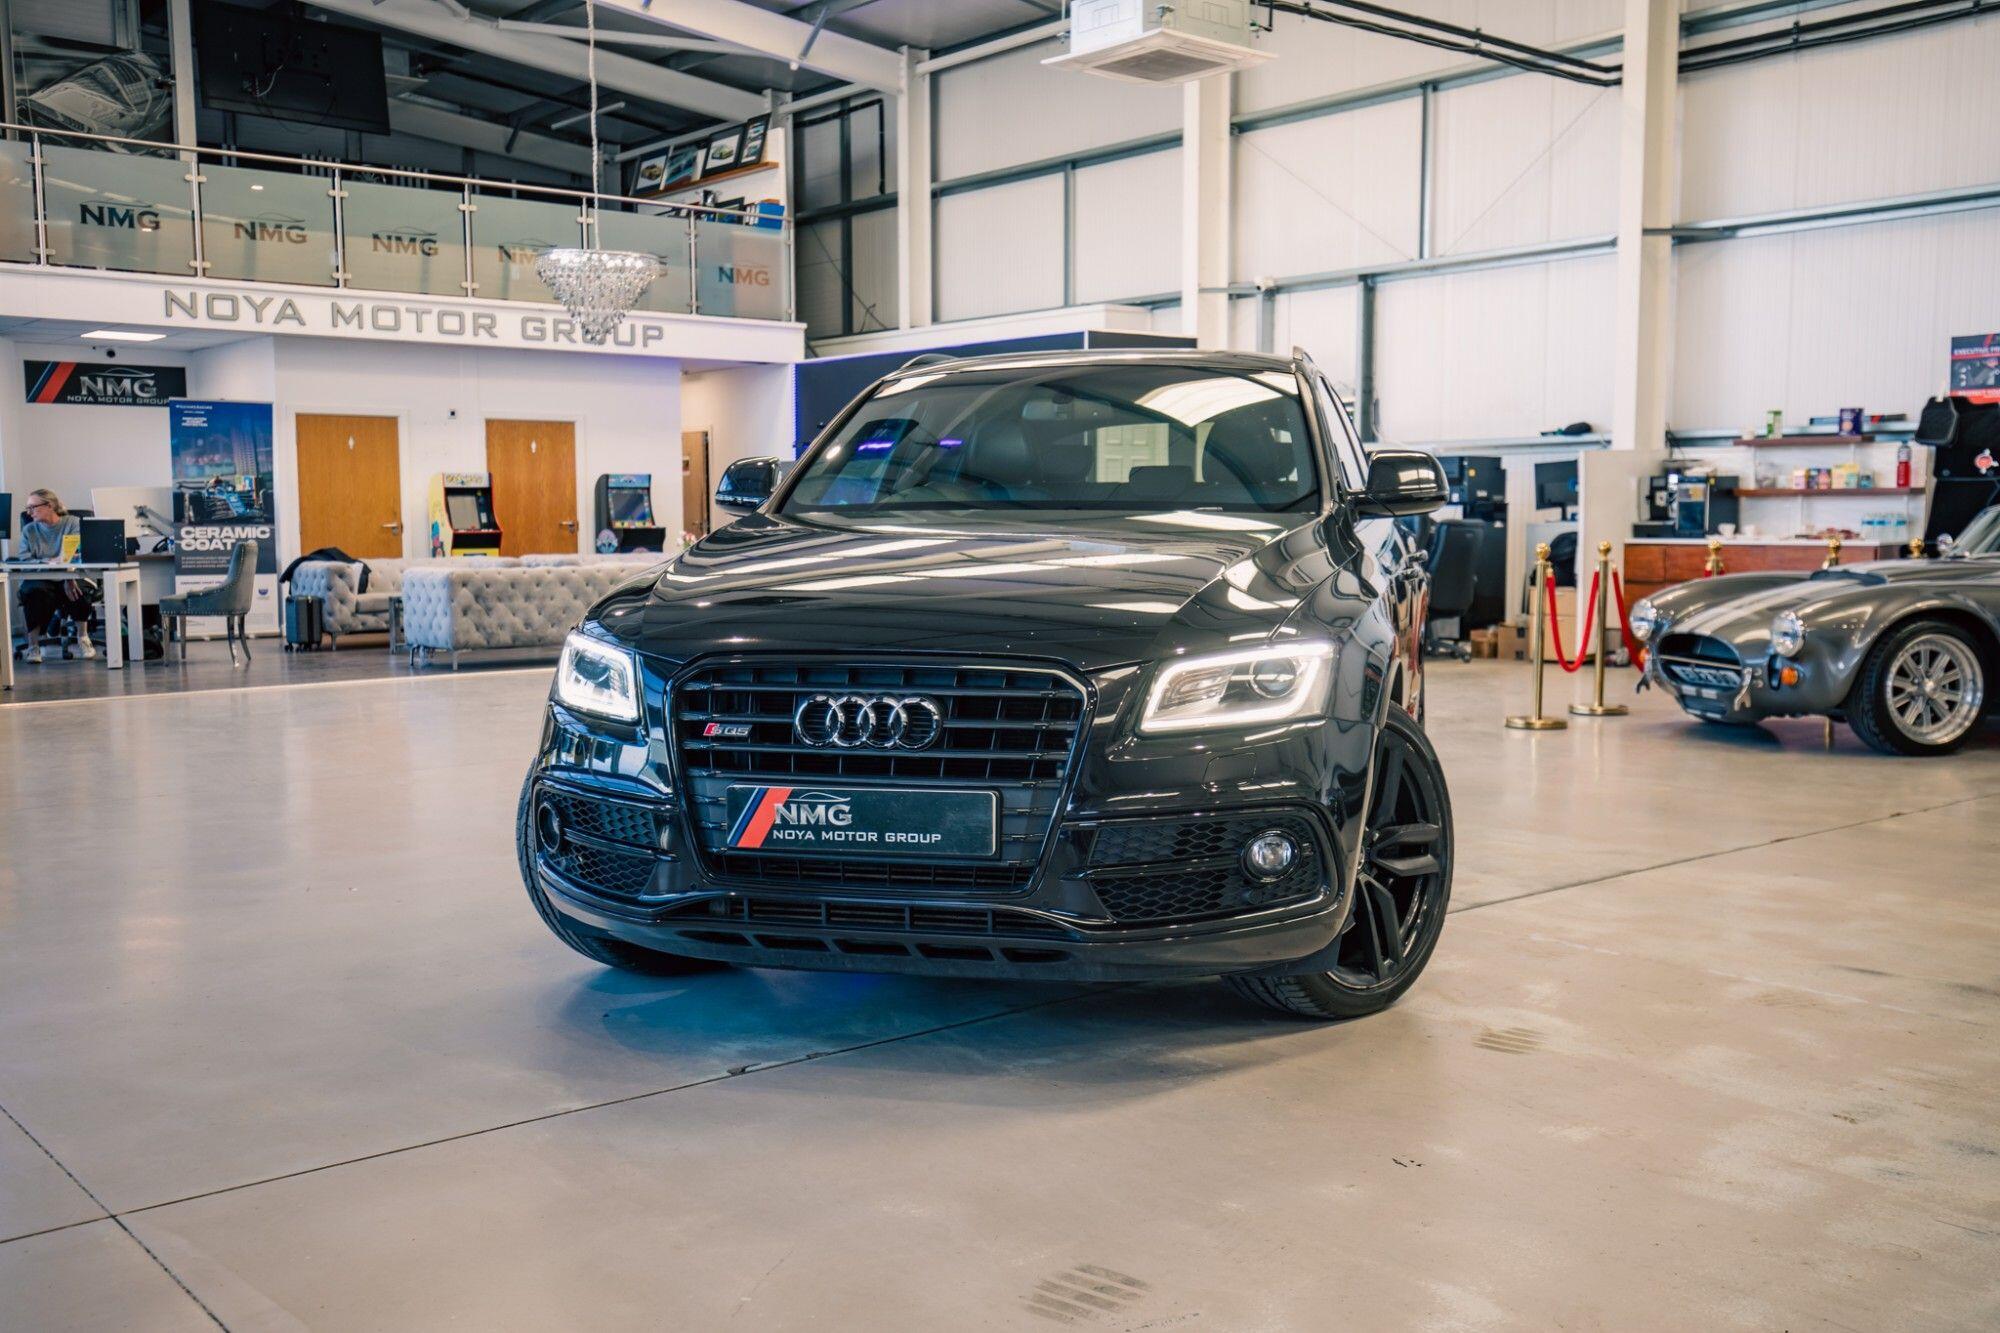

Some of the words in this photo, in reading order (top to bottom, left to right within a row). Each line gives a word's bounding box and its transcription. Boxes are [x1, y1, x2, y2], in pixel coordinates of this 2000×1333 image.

[80, 203, 161, 231] NMG
[234, 221, 308, 244] NMG
[371, 232, 439, 257] NMG
[718, 266, 770, 287] NMG
[164, 289, 306, 327] NOYA
[331, 301, 498, 338] MOTOR
[80, 376, 158, 398] NMG
[67, 395, 94, 403] NOYA
[98, 396, 134, 405] MOTOR
[180, 526, 271, 540] CERAMIC
[180, 538, 237, 552] COAT
[774, 803, 853, 827] NMG
[772, 829, 816, 841] NOYA
[821, 830, 879, 843] MOTOR
[884, 832, 942, 844] GROUP
